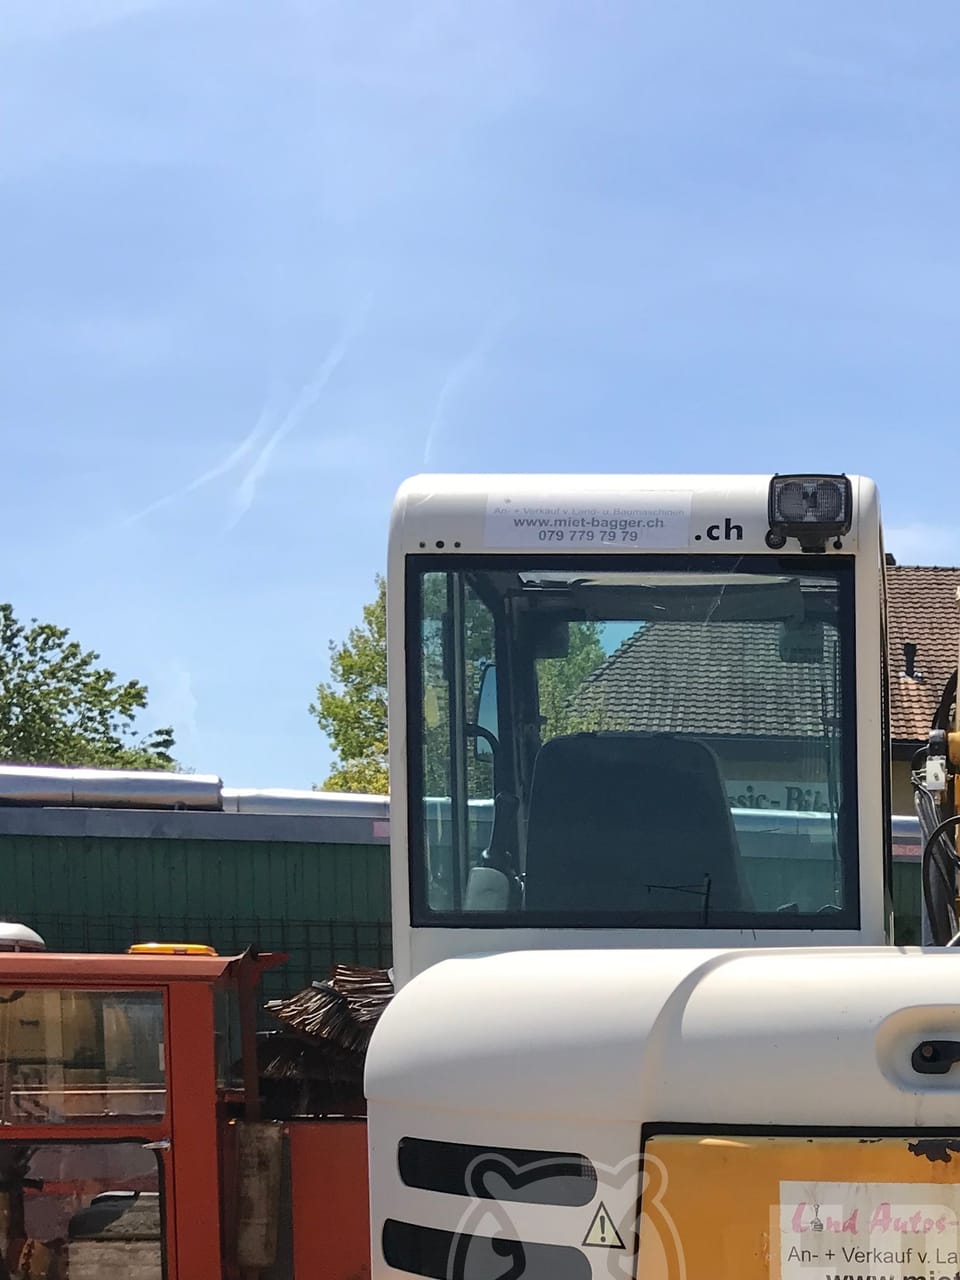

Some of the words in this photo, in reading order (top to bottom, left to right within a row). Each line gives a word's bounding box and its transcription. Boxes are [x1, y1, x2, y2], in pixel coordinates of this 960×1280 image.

[513, 517, 664, 530] www.miet-bagger.ch
[695, 518, 743, 541] .ch
[538, 530, 564, 541] 079
[569, 530, 594, 541] 779
[600, 530, 616, 541] 79
[621, 530, 638, 541] 79
[787, 1246, 819, 1262] An-
[825, 1250, 836, 1260] +
[842, 1247, 912, 1263] Verkauf
[917, 1251, 930, 1263] v.
